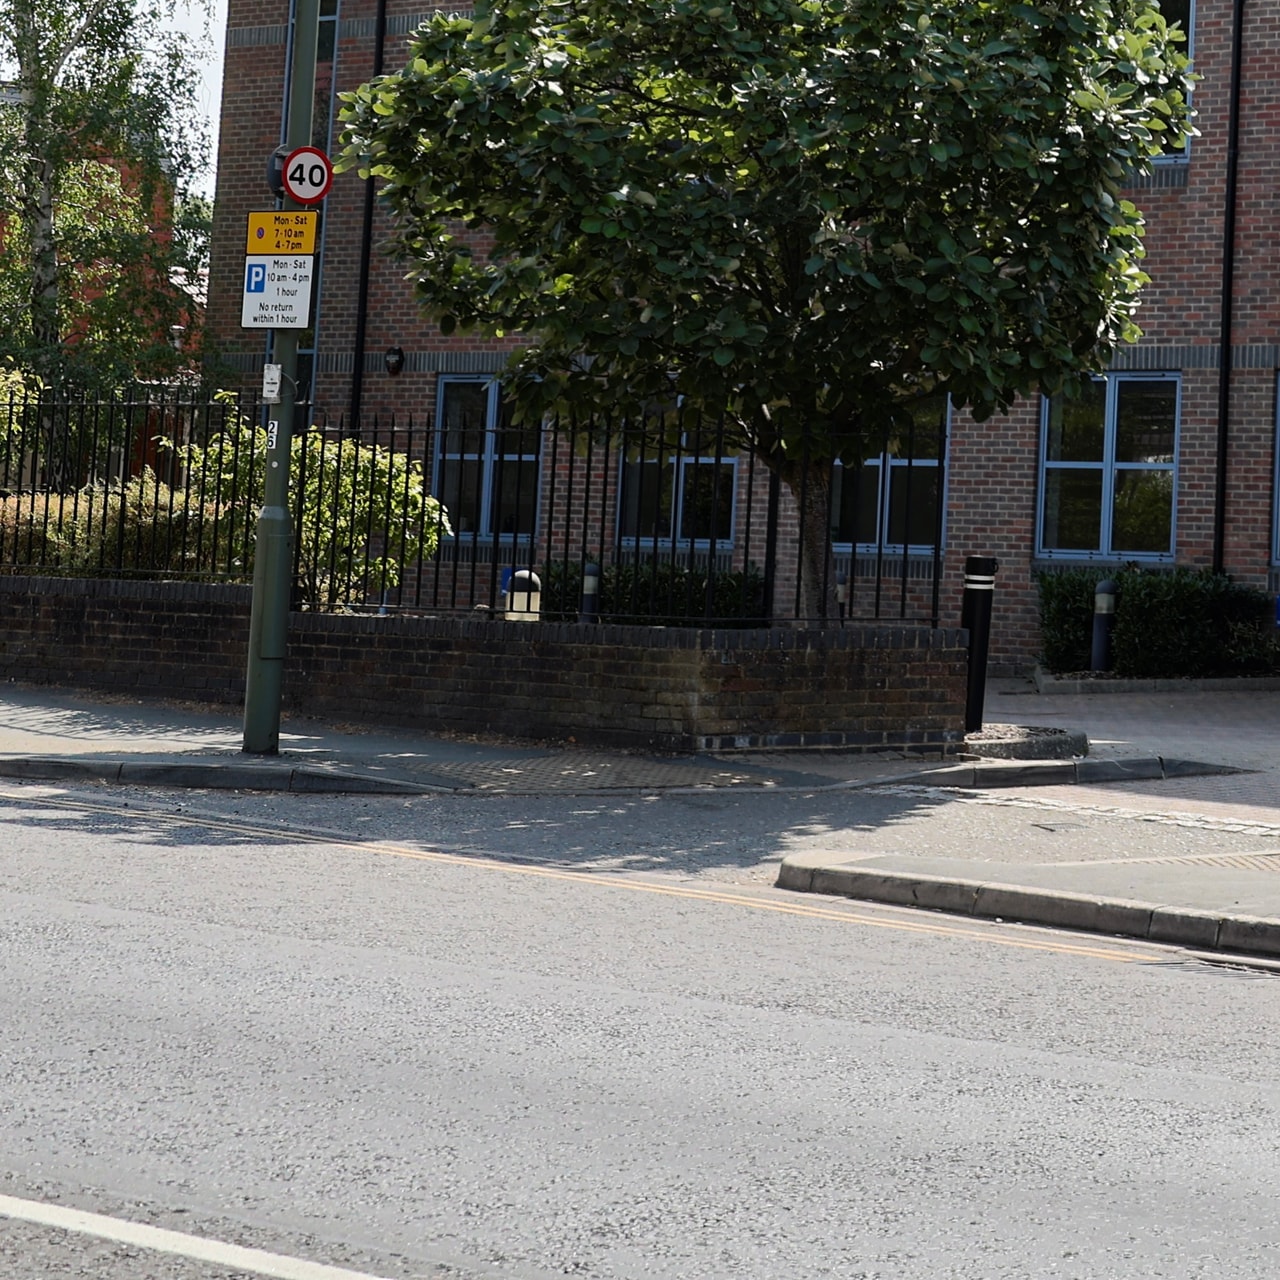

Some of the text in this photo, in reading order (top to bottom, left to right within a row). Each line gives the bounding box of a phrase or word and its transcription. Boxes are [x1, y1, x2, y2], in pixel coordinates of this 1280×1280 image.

[289, 163, 325, 187] 40
[274, 216, 289, 225] Mon
[294, 216, 307, 225] Sat
[273, 260, 288, 269] Mon
[293, 260, 306, 269] Sat
[251, 267, 263, 290] P
[267, 273, 276, 282] 10
[292, 273, 297, 281] 4
[299, 275, 309, 284] pm
[281, 287, 298, 297] hour
[259, 302, 293, 312] No return
[253, 313, 274, 323] within
[281, 314, 297, 323] hour
